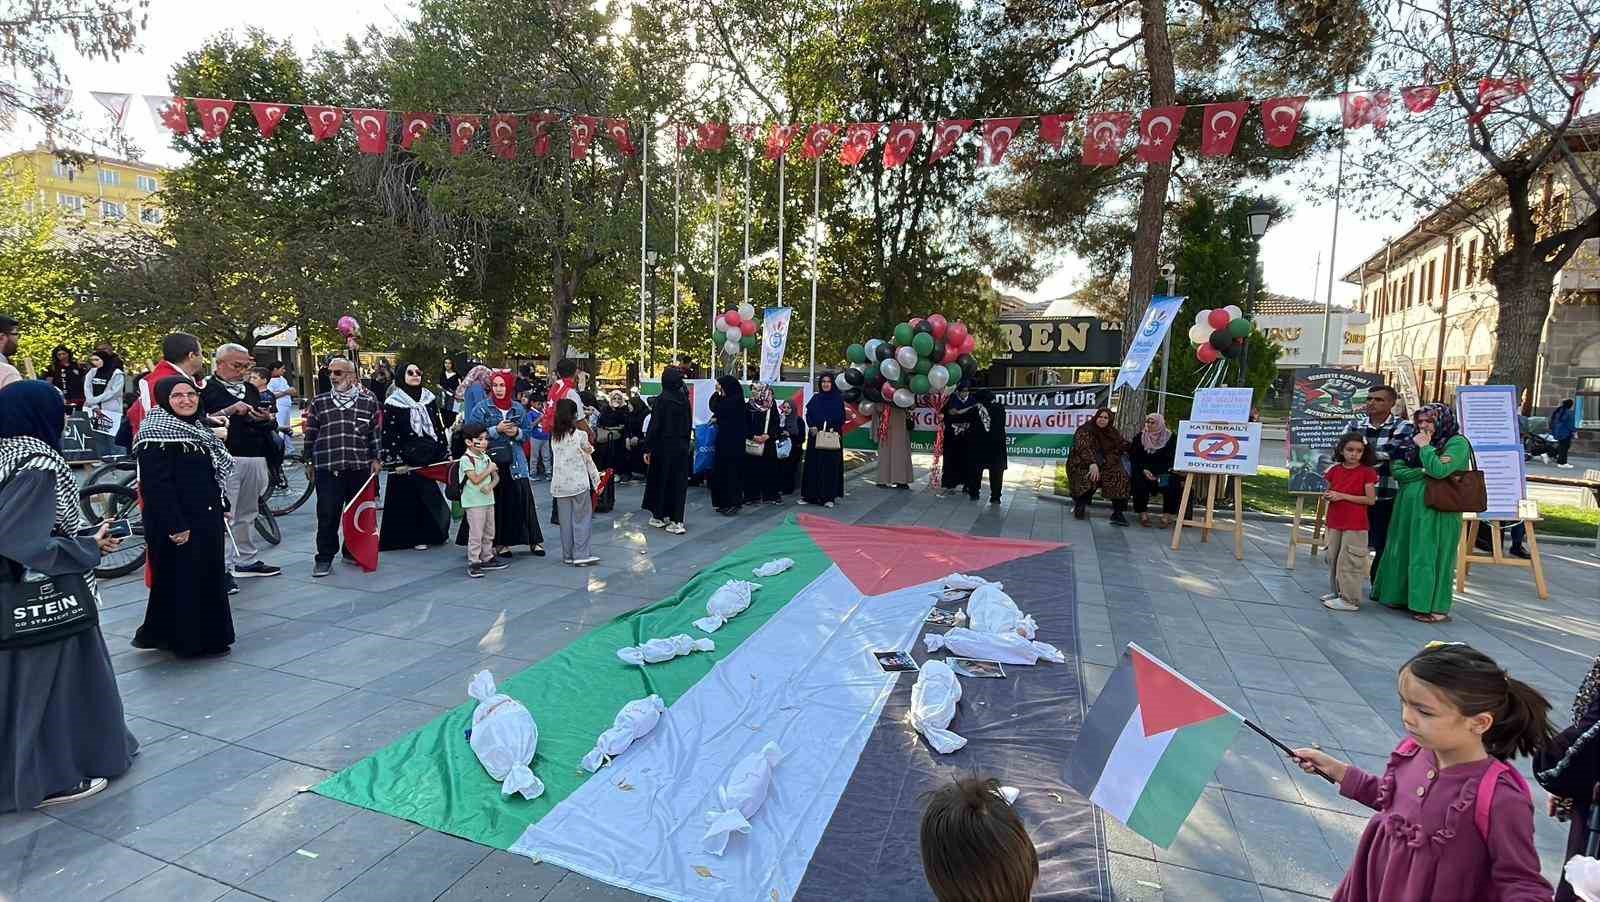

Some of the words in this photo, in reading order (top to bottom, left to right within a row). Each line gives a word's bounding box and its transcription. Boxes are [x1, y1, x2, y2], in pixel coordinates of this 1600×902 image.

[999, 322, 1090, 352] REN
[995, 391, 1049, 407] DÜNYA
[1054, 390, 1096, 406] ÖLÜR
[1006, 411, 1041, 428] ÜNYA
[13, 595, 78, 619] STEIN
